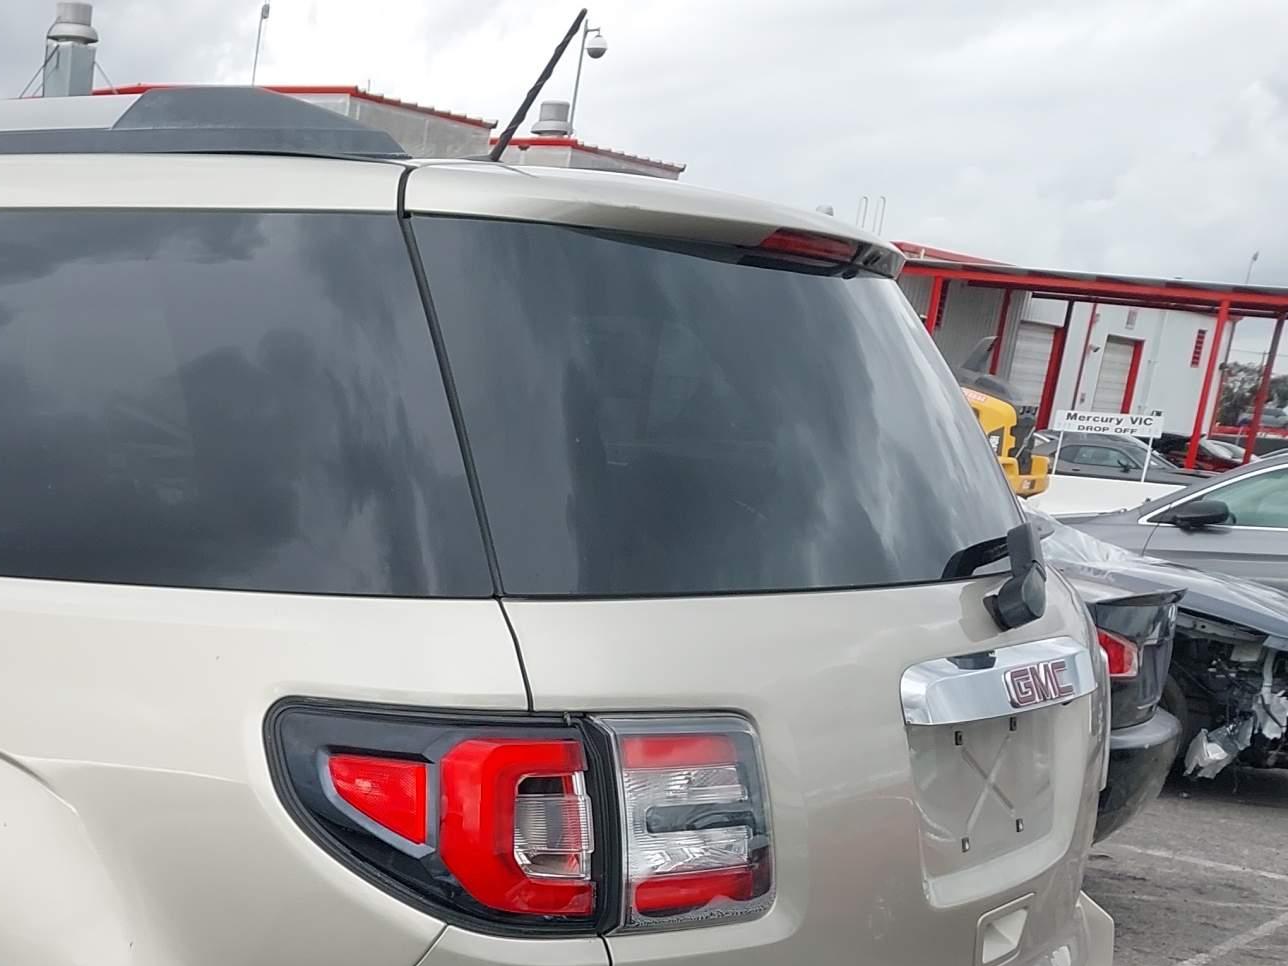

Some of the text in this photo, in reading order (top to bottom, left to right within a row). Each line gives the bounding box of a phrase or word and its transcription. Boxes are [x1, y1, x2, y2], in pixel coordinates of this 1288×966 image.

[1065, 412, 1154, 427] Mercury VIC
[1077, 424, 1138, 435] DROP OFF
[1009, 659, 1075, 707] GMC
